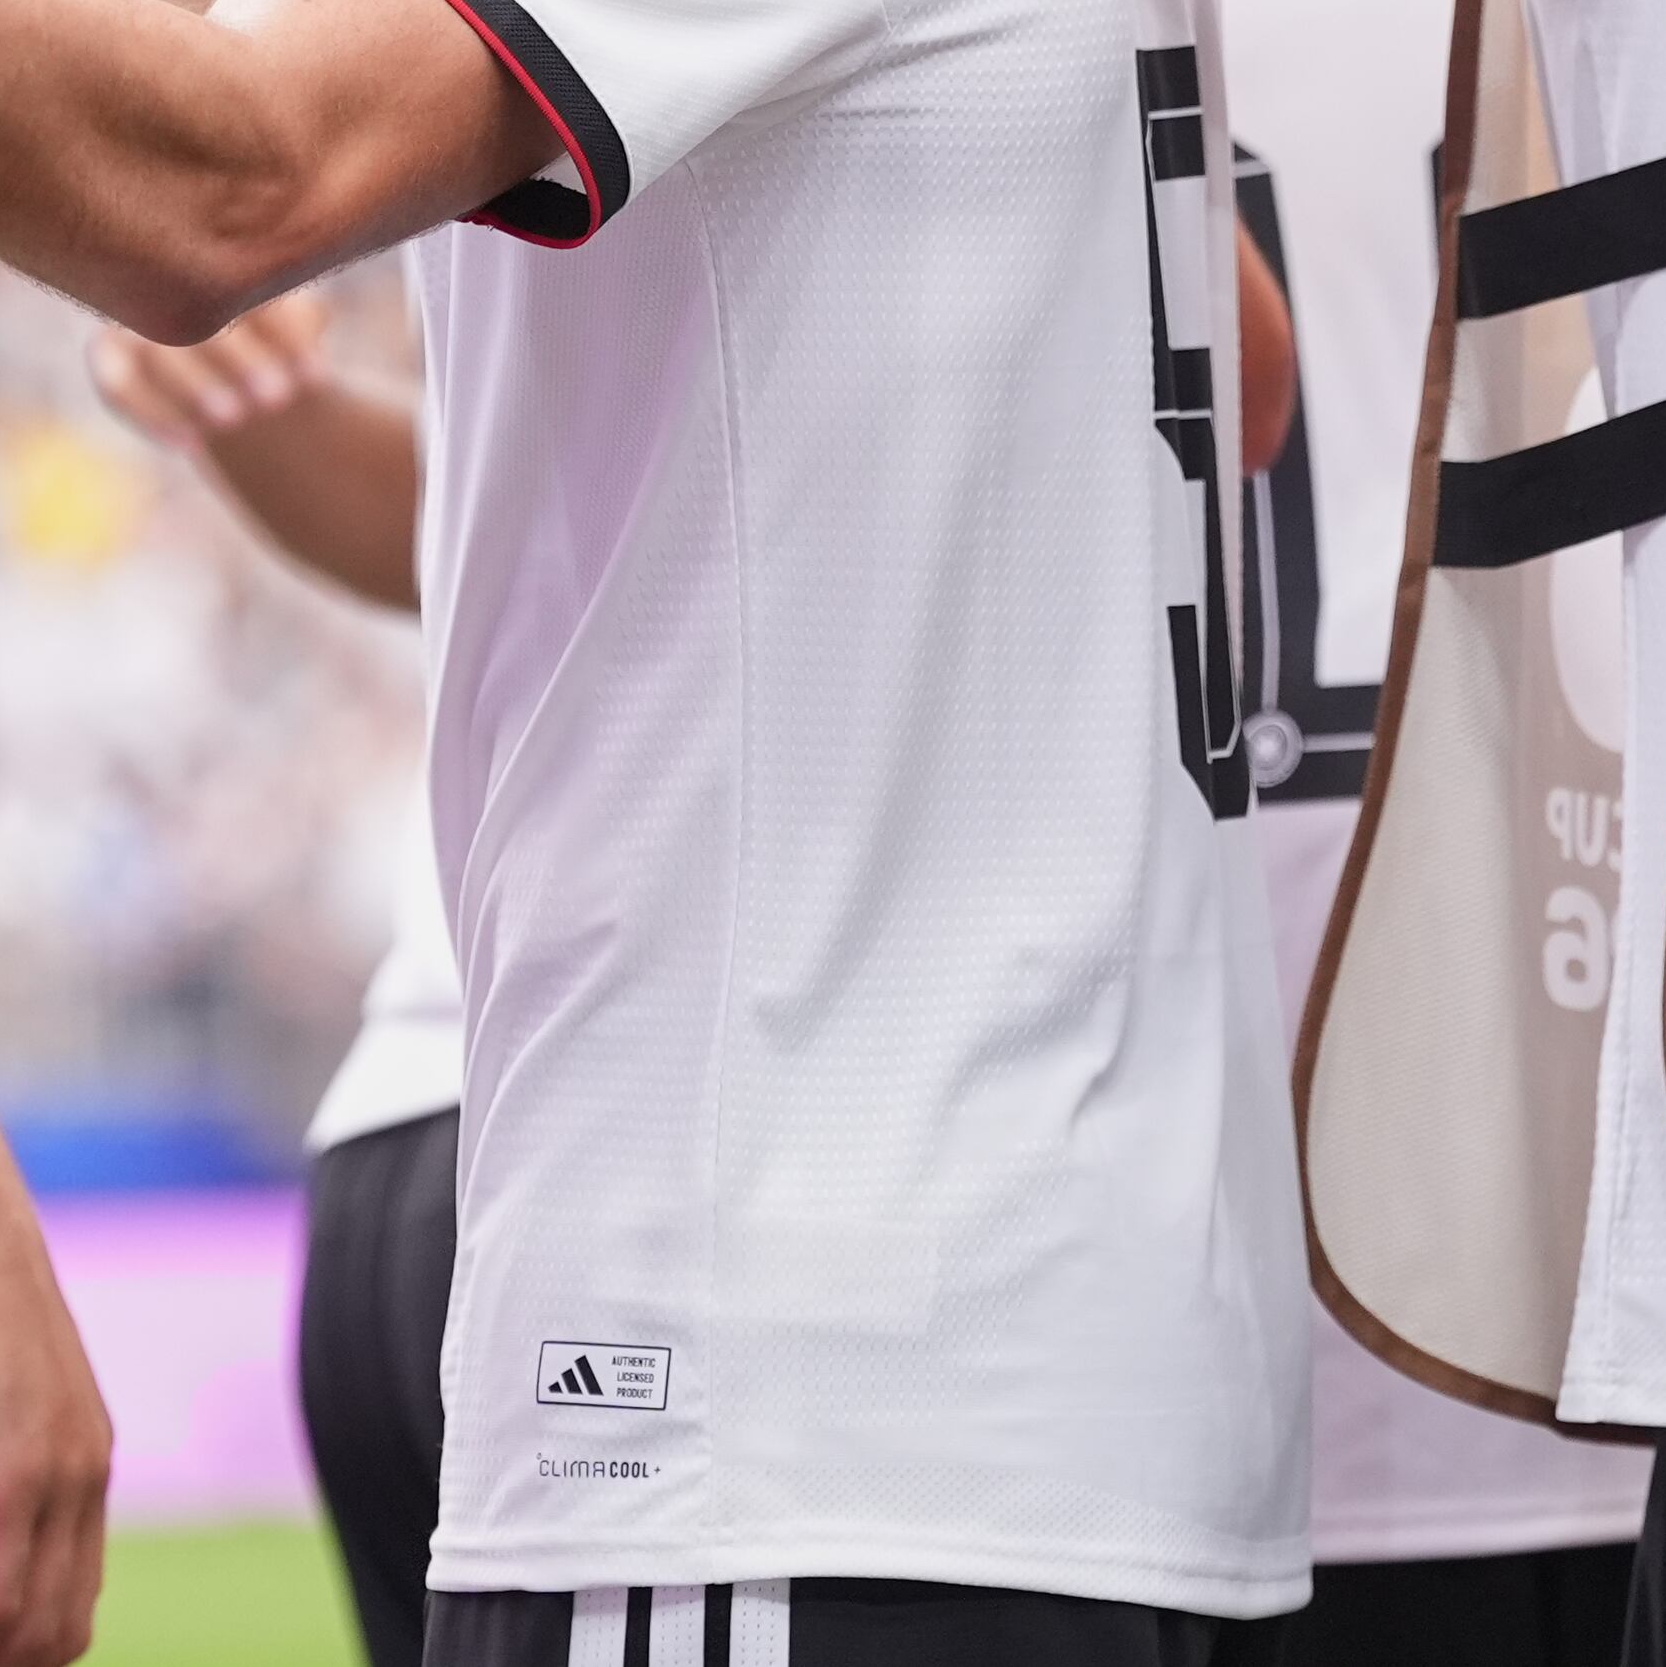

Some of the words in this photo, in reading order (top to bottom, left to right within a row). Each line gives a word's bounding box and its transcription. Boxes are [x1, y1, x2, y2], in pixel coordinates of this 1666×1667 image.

[611, 1355, 656, 1368] AUTHENTIC
[617, 1372, 654, 1383] LICENSED
[616, 1387, 653, 1399] PRODUCT
